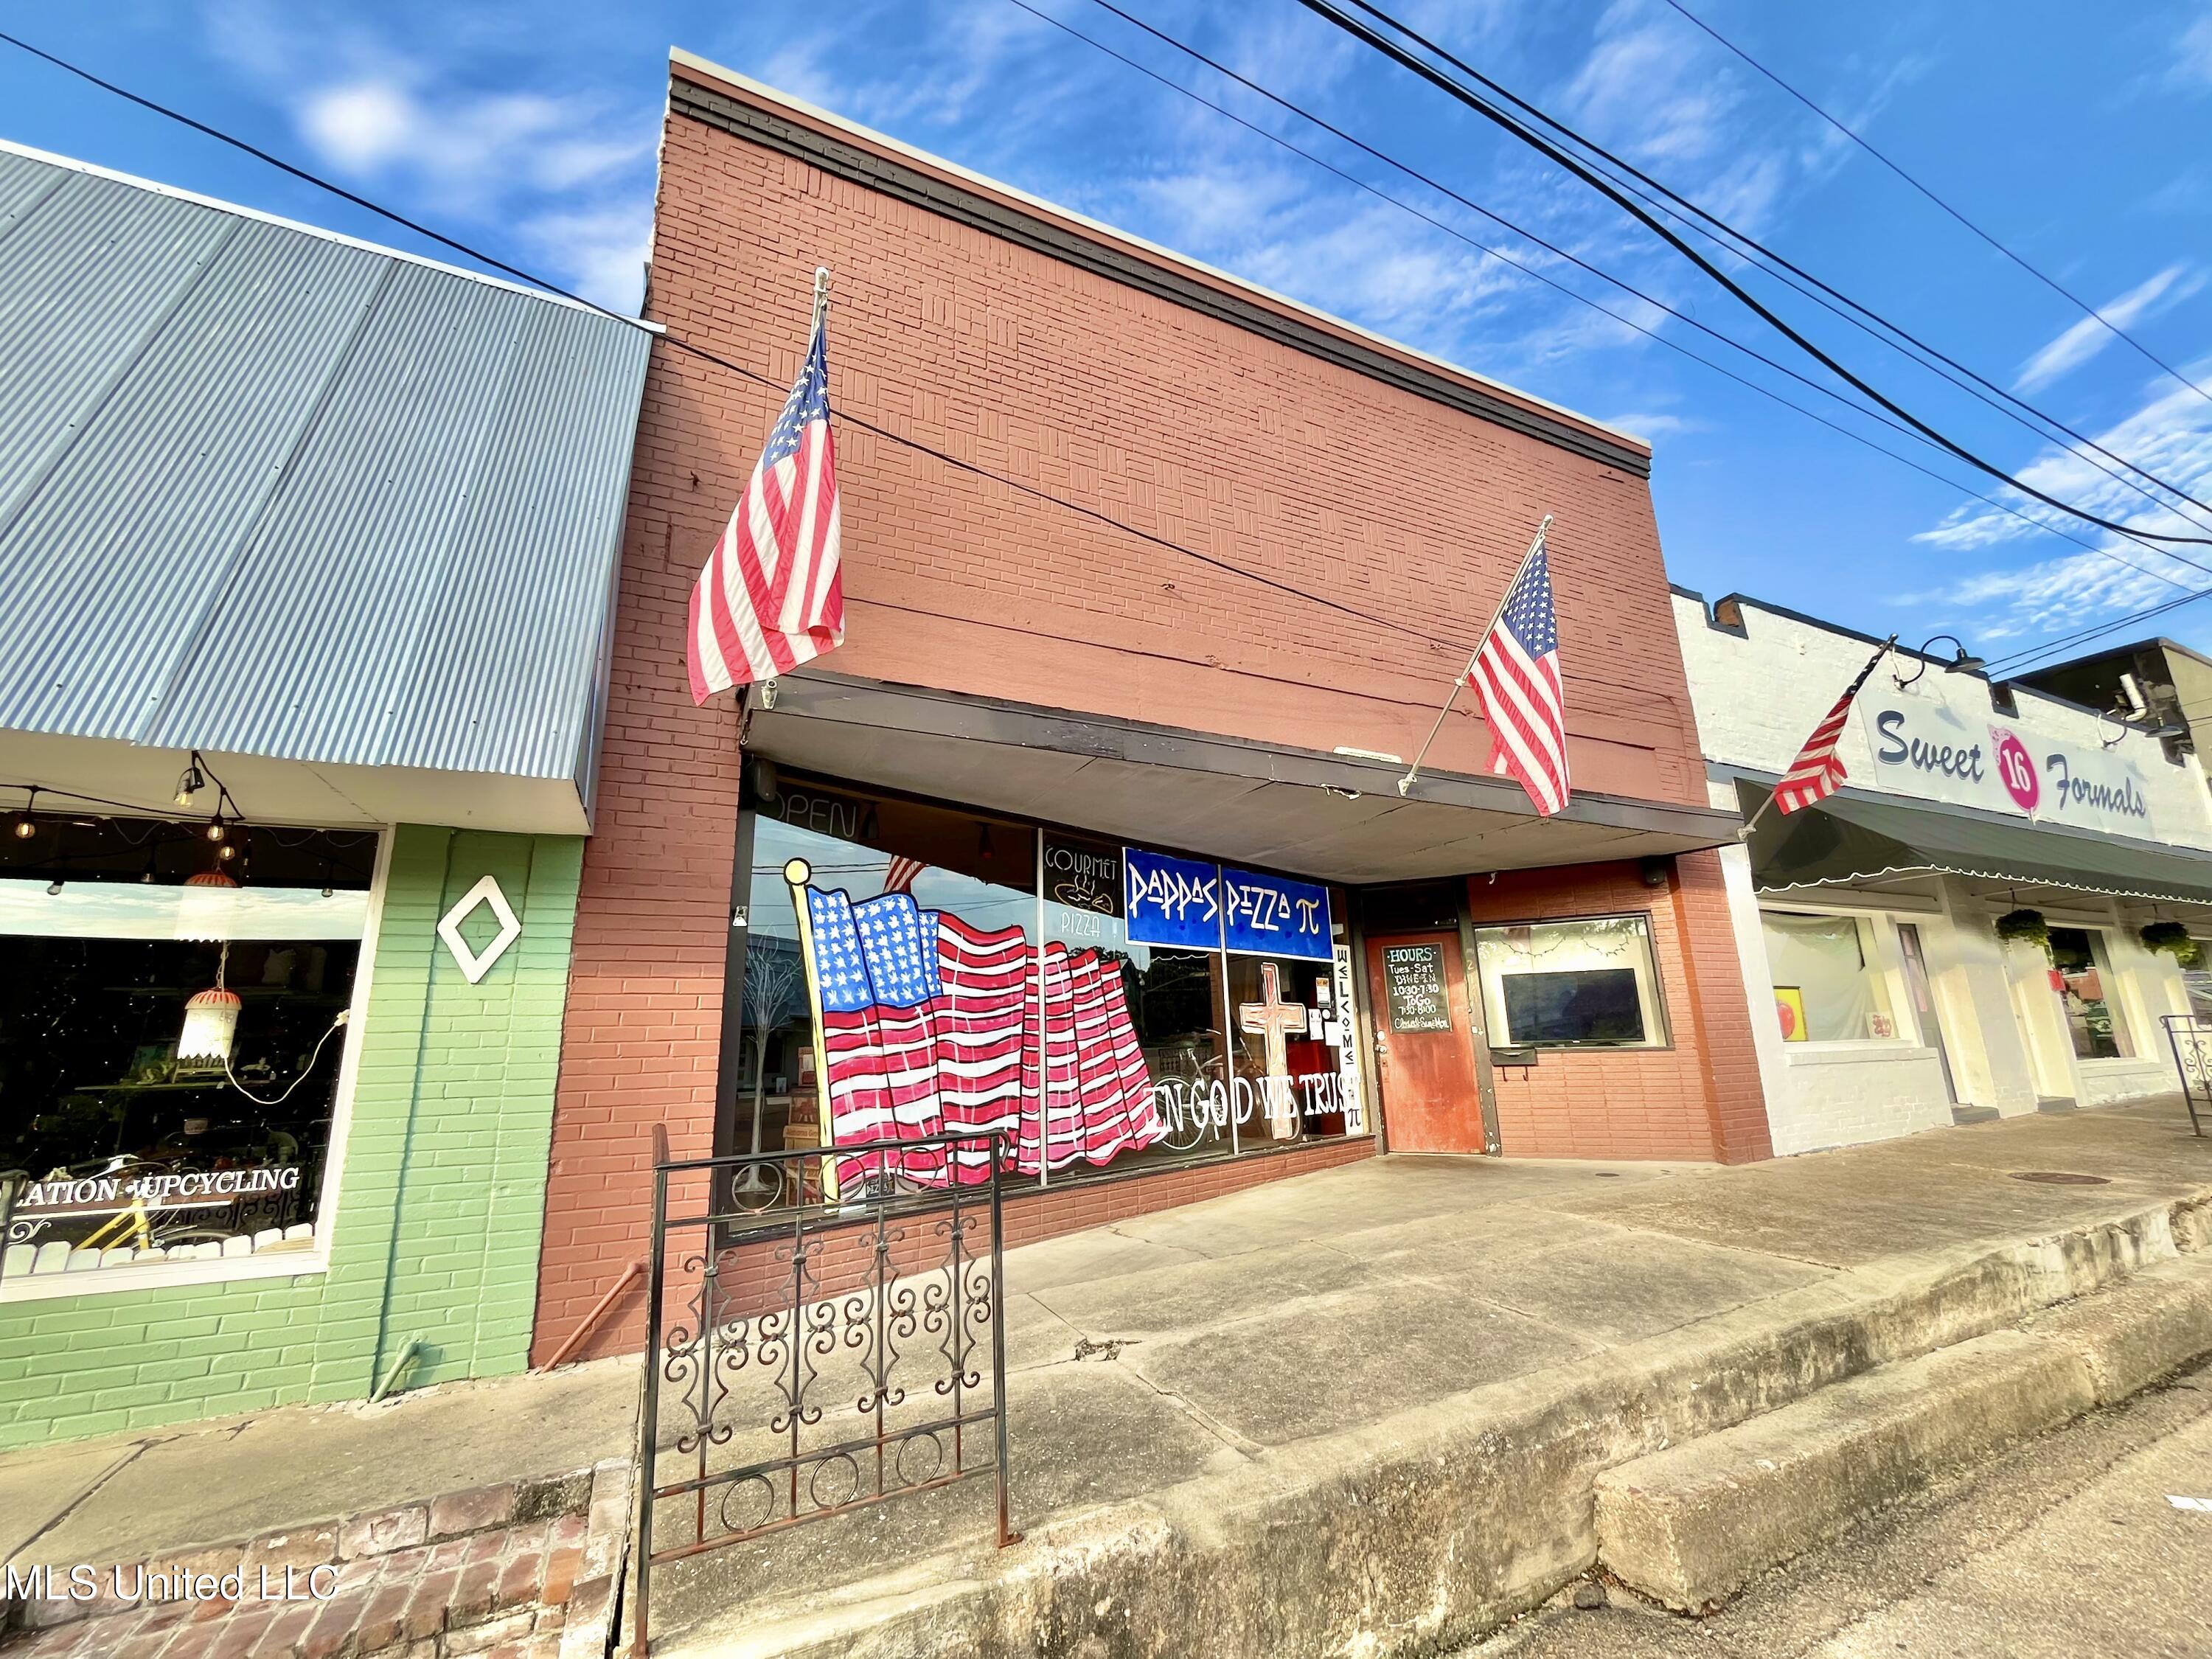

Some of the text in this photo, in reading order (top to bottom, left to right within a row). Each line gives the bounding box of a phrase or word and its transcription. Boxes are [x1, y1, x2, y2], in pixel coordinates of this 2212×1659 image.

[1877, 710, 2146, 818] Sweet 16 Formals
[1128, 862, 1218, 922] PAPPAS
[1225, 880, 1291, 932] PIZZA
[1061, 912, 1100, 938] PIZZA
[1389, 947, 1433, 963] HOURS
[1143, 1083, 1184, 1133] IN
[1190, 1076, 1253, 1129] GOD
[1255, 1074, 1298, 1119] WE
[15, 1166, 300, 1208] ATION UPCYCLING
